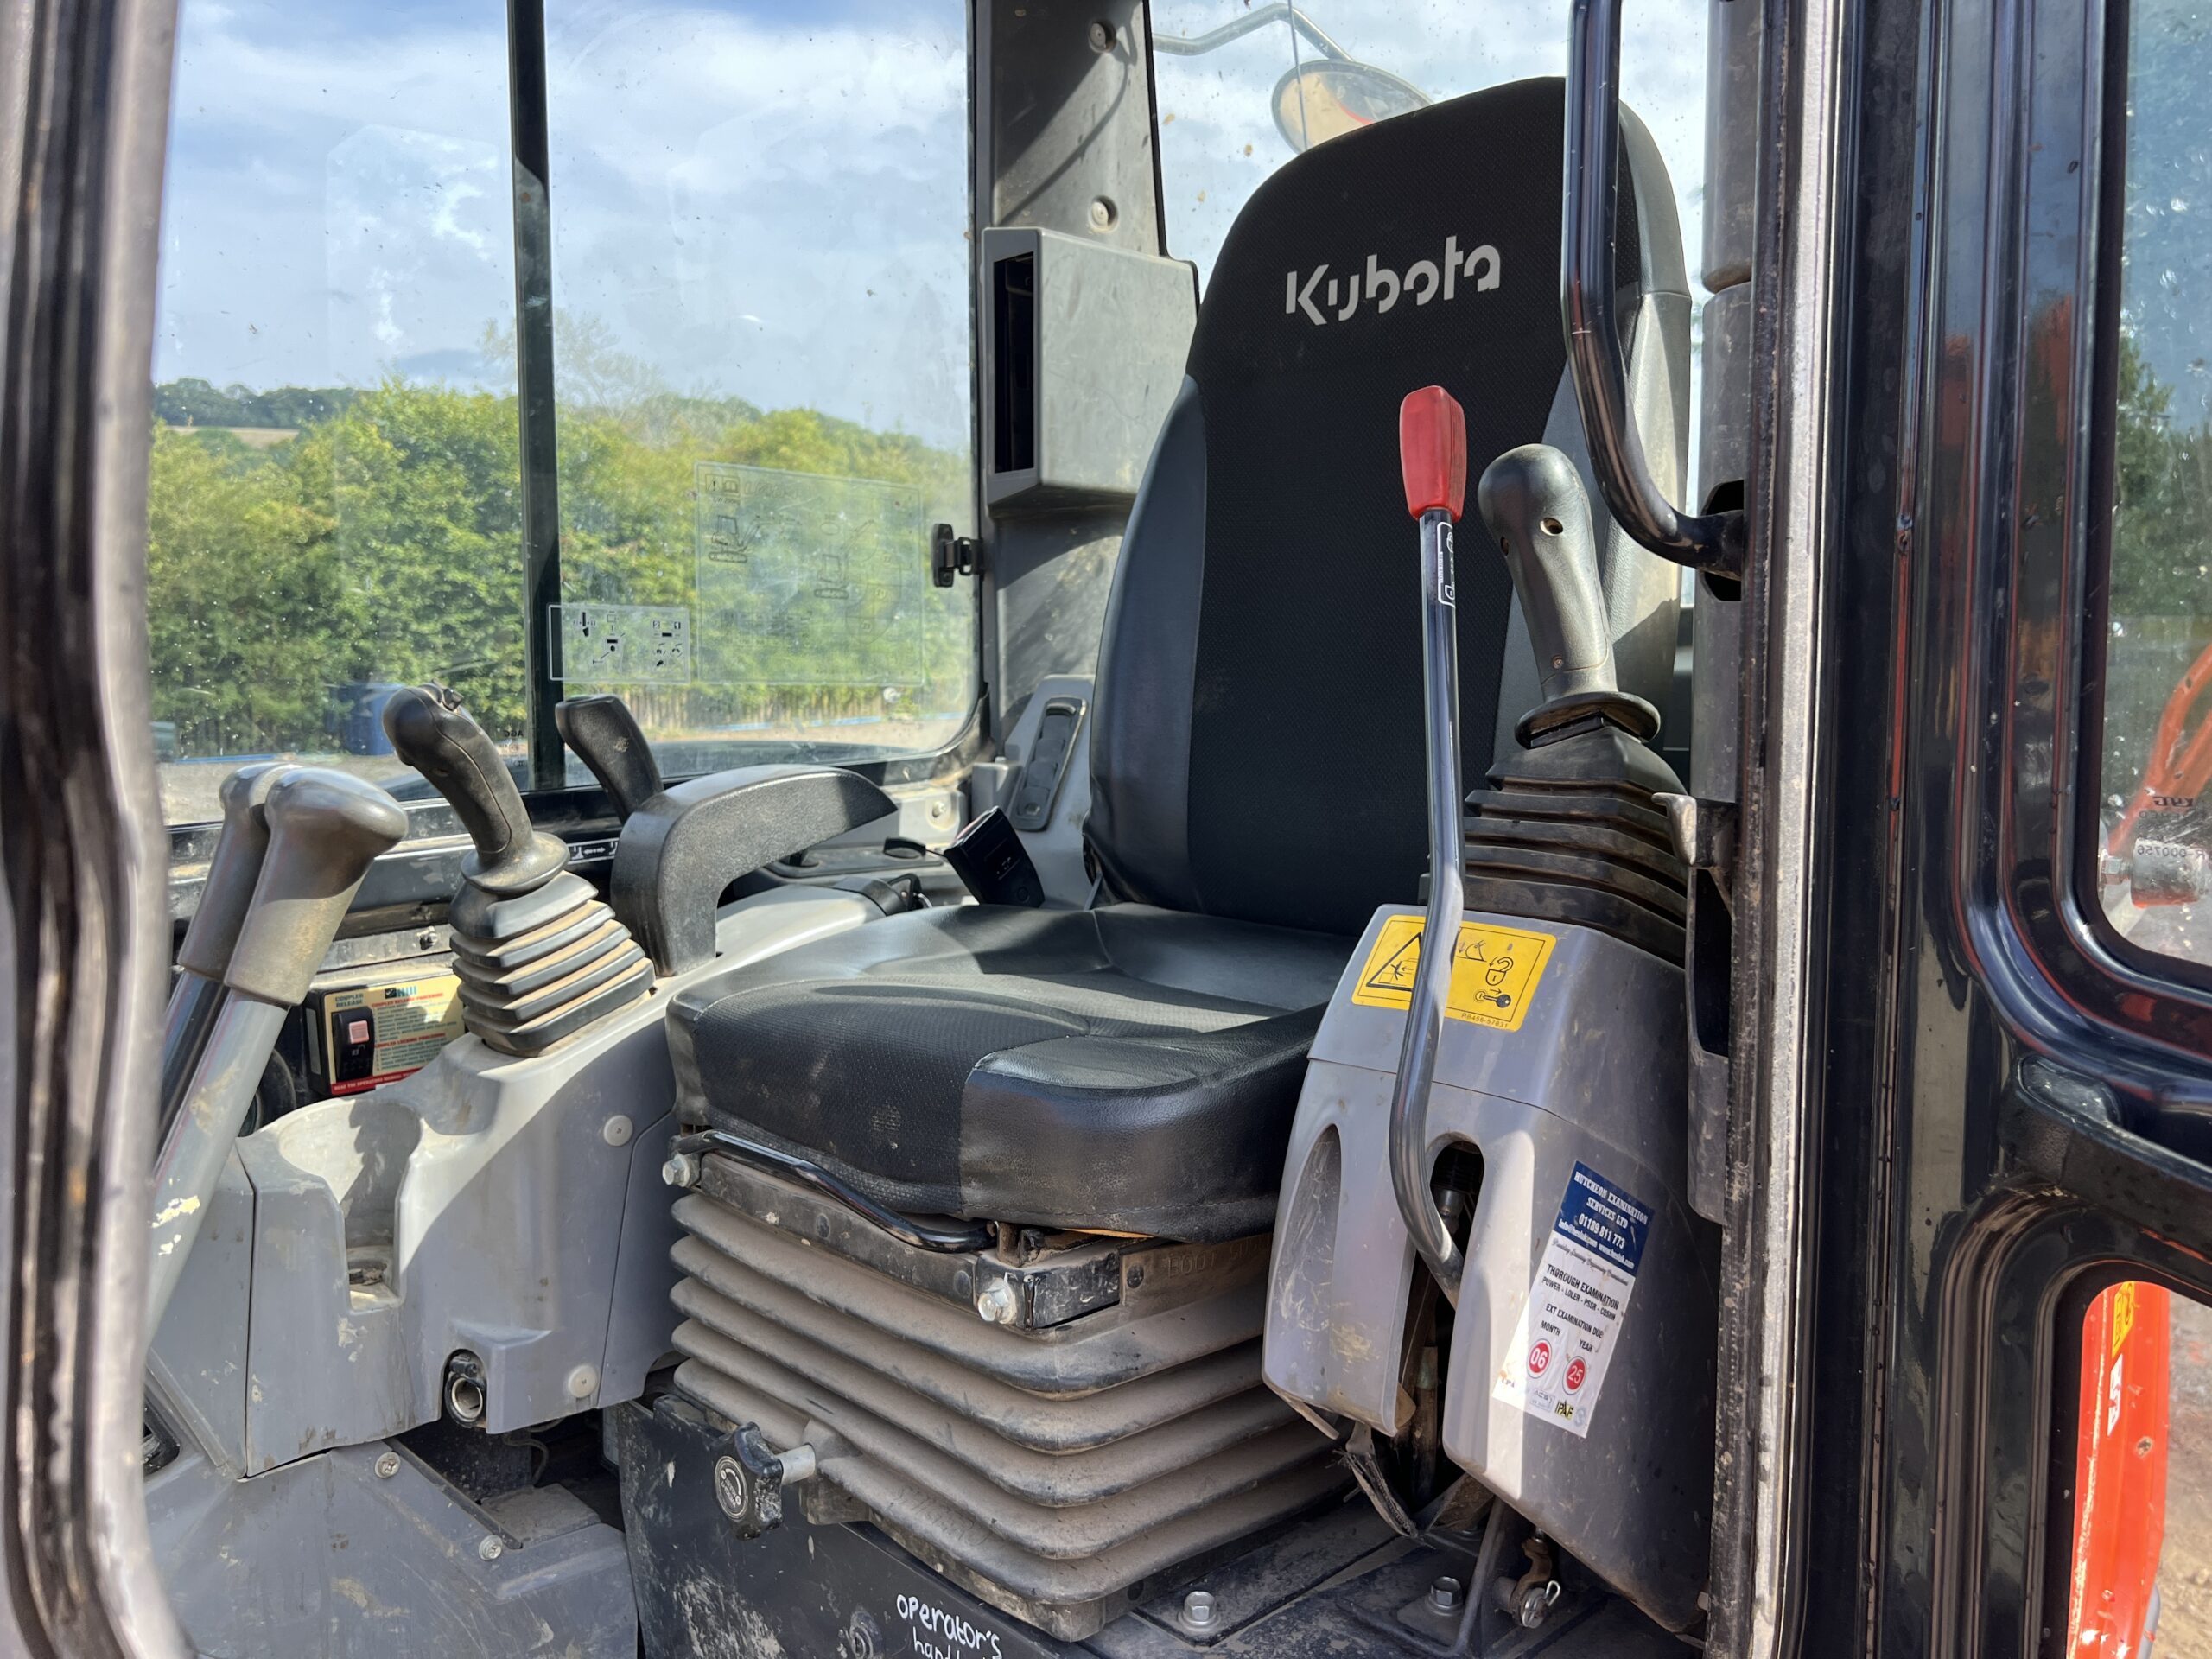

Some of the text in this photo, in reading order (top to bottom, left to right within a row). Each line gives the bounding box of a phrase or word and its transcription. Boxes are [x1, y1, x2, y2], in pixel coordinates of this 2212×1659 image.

[1286, 235, 1501, 326] Kubota
[1574, 1171, 1649, 1224] HUTCHEON EXAMINATION
[1586, 1197, 1629, 1229] SERVICES LTD
[1579, 1213, 1625, 1249] 01189 811 773
[1542, 1276, 1561, 1292] PUWER
[1565, 1288, 1581, 1303] LOLER
[1583, 1298, 1598, 1312] PSSR
[1547, 1264, 1581, 1289] THOROUGH
[1580, 1282, 1620, 1311] EXAMINATION
[1541, 1320, 1561, 1337] MONTH
[1556, 1309, 1592, 1333] EXAMINATION
[1592, 1326, 1604, 1339] DUE
[1530, 1347, 1548, 1369] 06
[1579, 1339, 1593, 1353] YEAR
[1568, 1365, 1584, 1384] 25
[1554, 1399, 1574, 1418] IPAF
